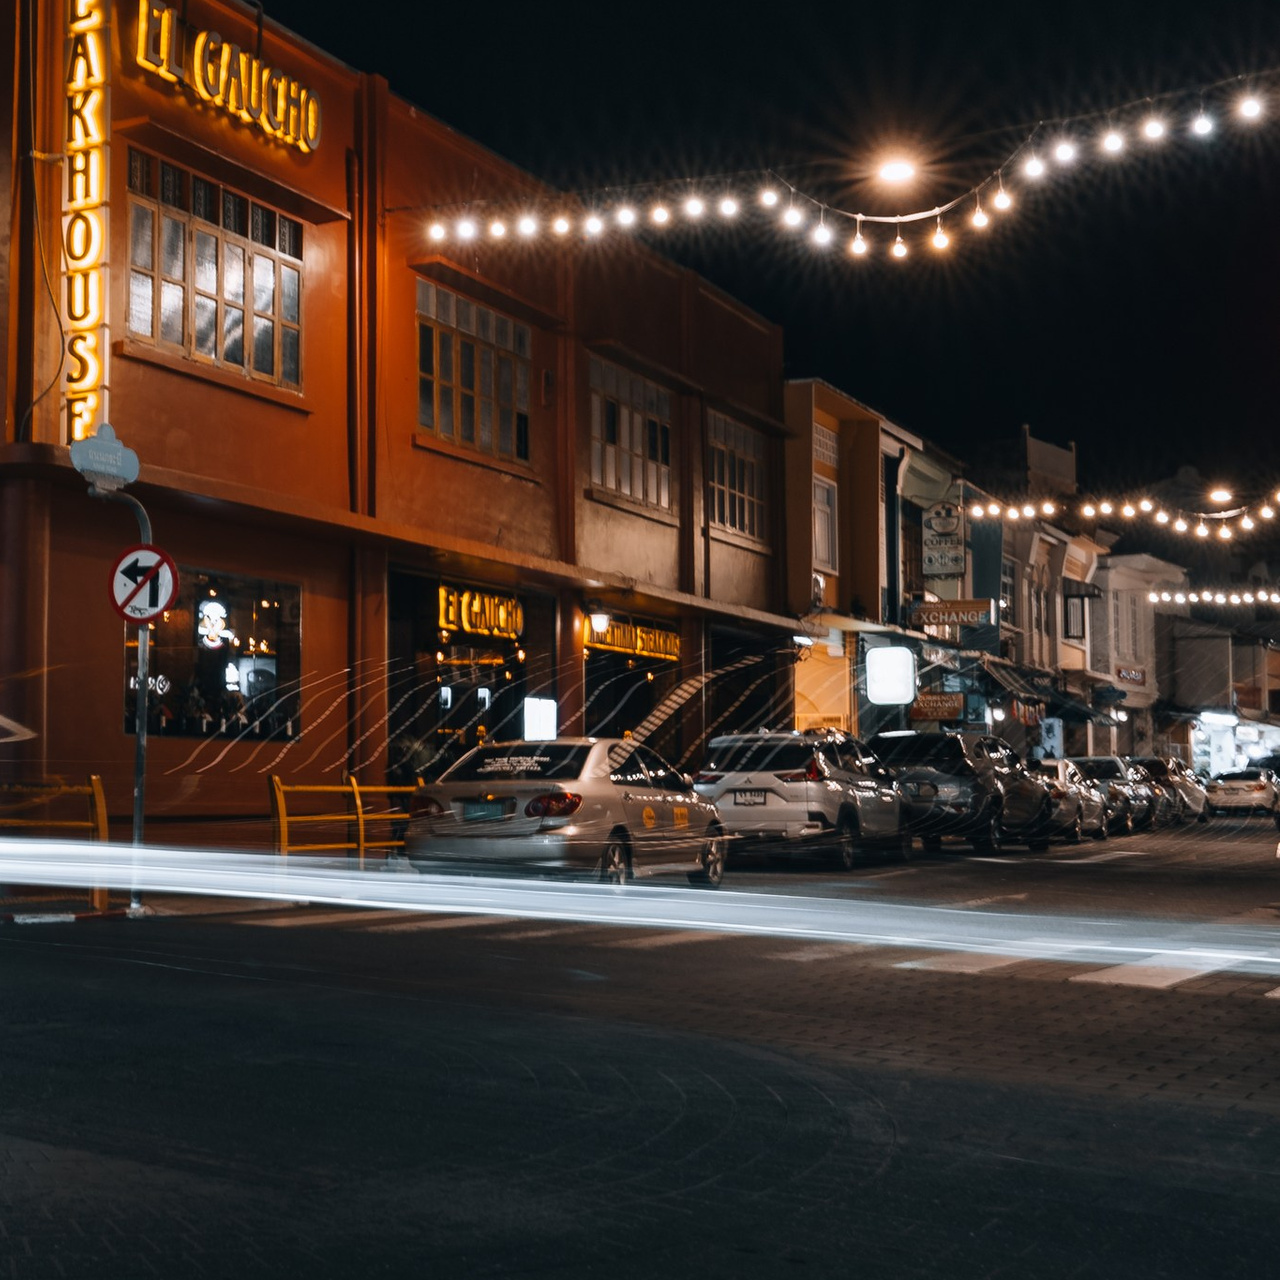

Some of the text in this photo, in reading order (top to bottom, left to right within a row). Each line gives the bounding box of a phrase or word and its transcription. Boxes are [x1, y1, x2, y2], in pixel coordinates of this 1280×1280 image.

[194, 31, 322, 153] GAUCHO
[924, 537, 963, 547] COFFEE
[439, 585, 524, 640] EL GAUCHO
[911, 611, 986, 624] EXCHANGE
